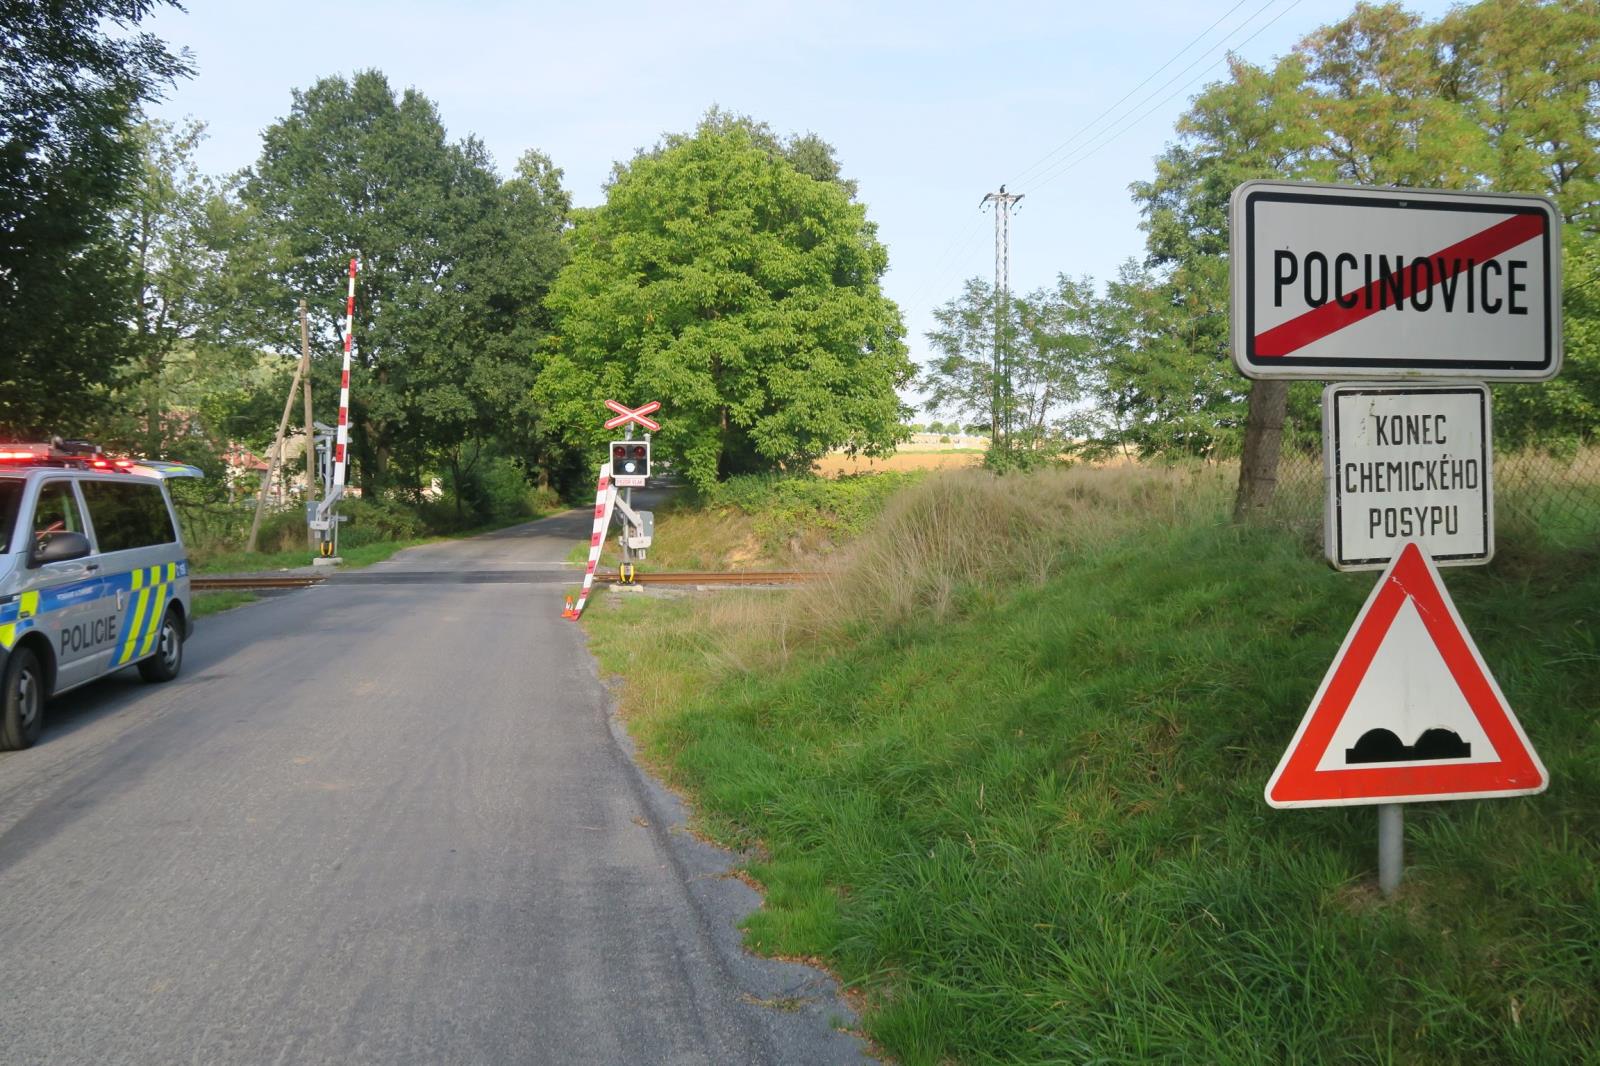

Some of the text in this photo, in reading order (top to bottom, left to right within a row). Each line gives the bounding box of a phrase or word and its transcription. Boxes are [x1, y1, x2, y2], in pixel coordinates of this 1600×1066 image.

[1274, 249, 1528, 315] POCINOVICE
[1376, 414, 1447, 446] KONEC
[1345, 454, 1478, 493] CHEMICKÉHO
[1369, 505, 1459, 539] POSYPU
[61, 615, 116, 656] POLICIE
